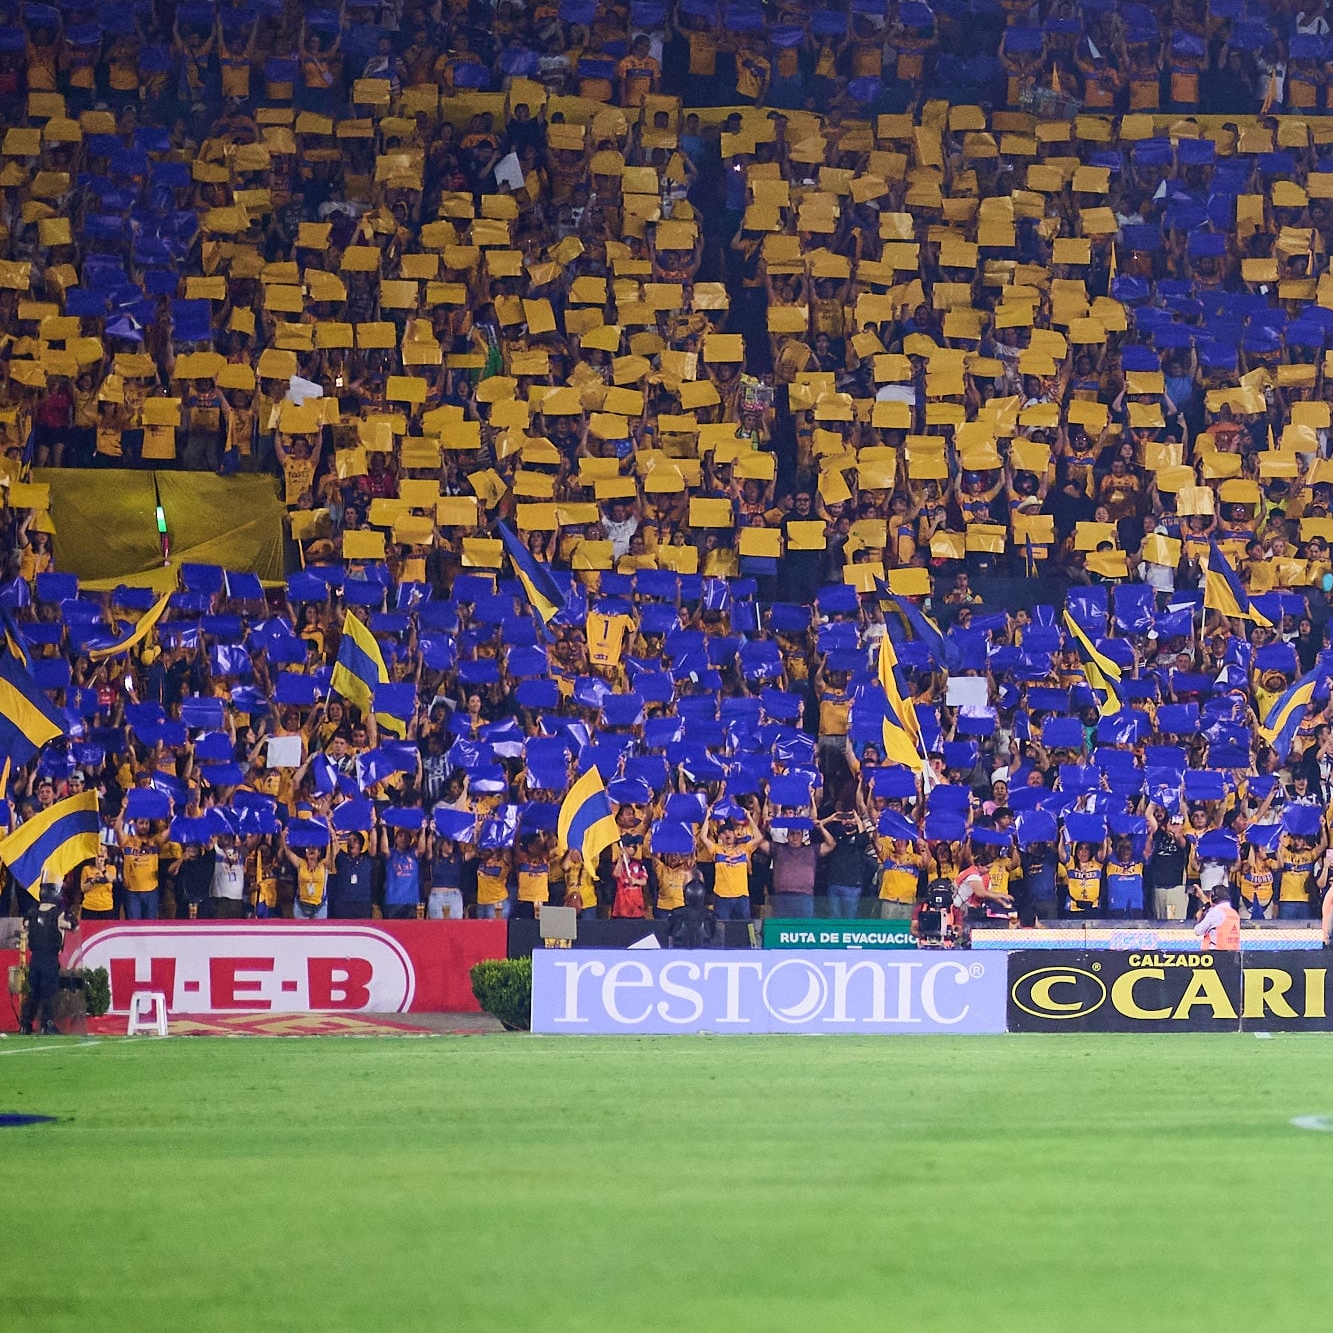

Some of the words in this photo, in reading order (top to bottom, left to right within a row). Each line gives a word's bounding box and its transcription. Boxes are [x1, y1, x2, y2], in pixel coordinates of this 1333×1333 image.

[780, 933, 815, 944] RUTA
[819, 933, 838, 944] DE
[1129, 954, 1214, 967] CALZADO
[109, 957, 374, 1010] H-E-B
